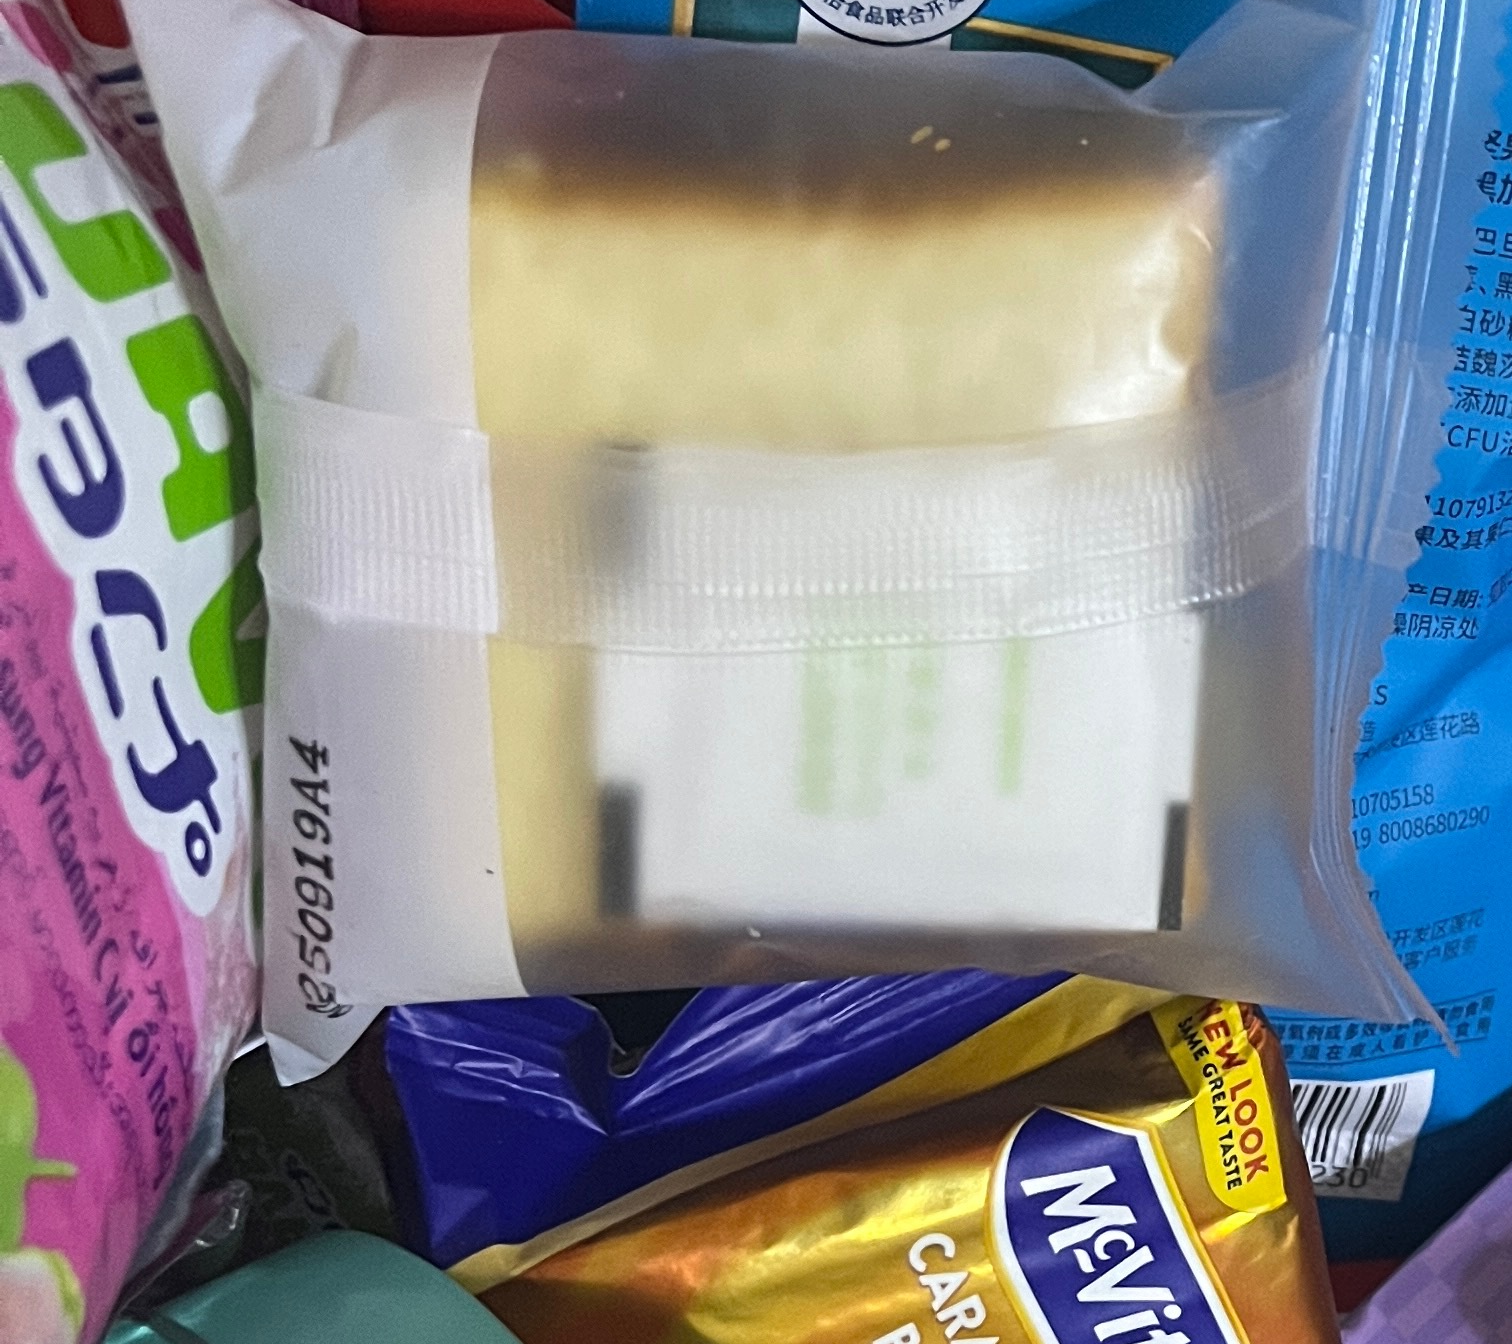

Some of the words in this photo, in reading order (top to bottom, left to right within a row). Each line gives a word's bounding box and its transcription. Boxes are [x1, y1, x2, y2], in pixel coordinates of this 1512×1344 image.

[1177, 1017, 1213, 1066] SAME
[1199, 1052, 1232, 1124] GREAT
[1217, 1123, 1243, 1191] TASTE
[1227, 1066, 1276, 1183] LOOK
